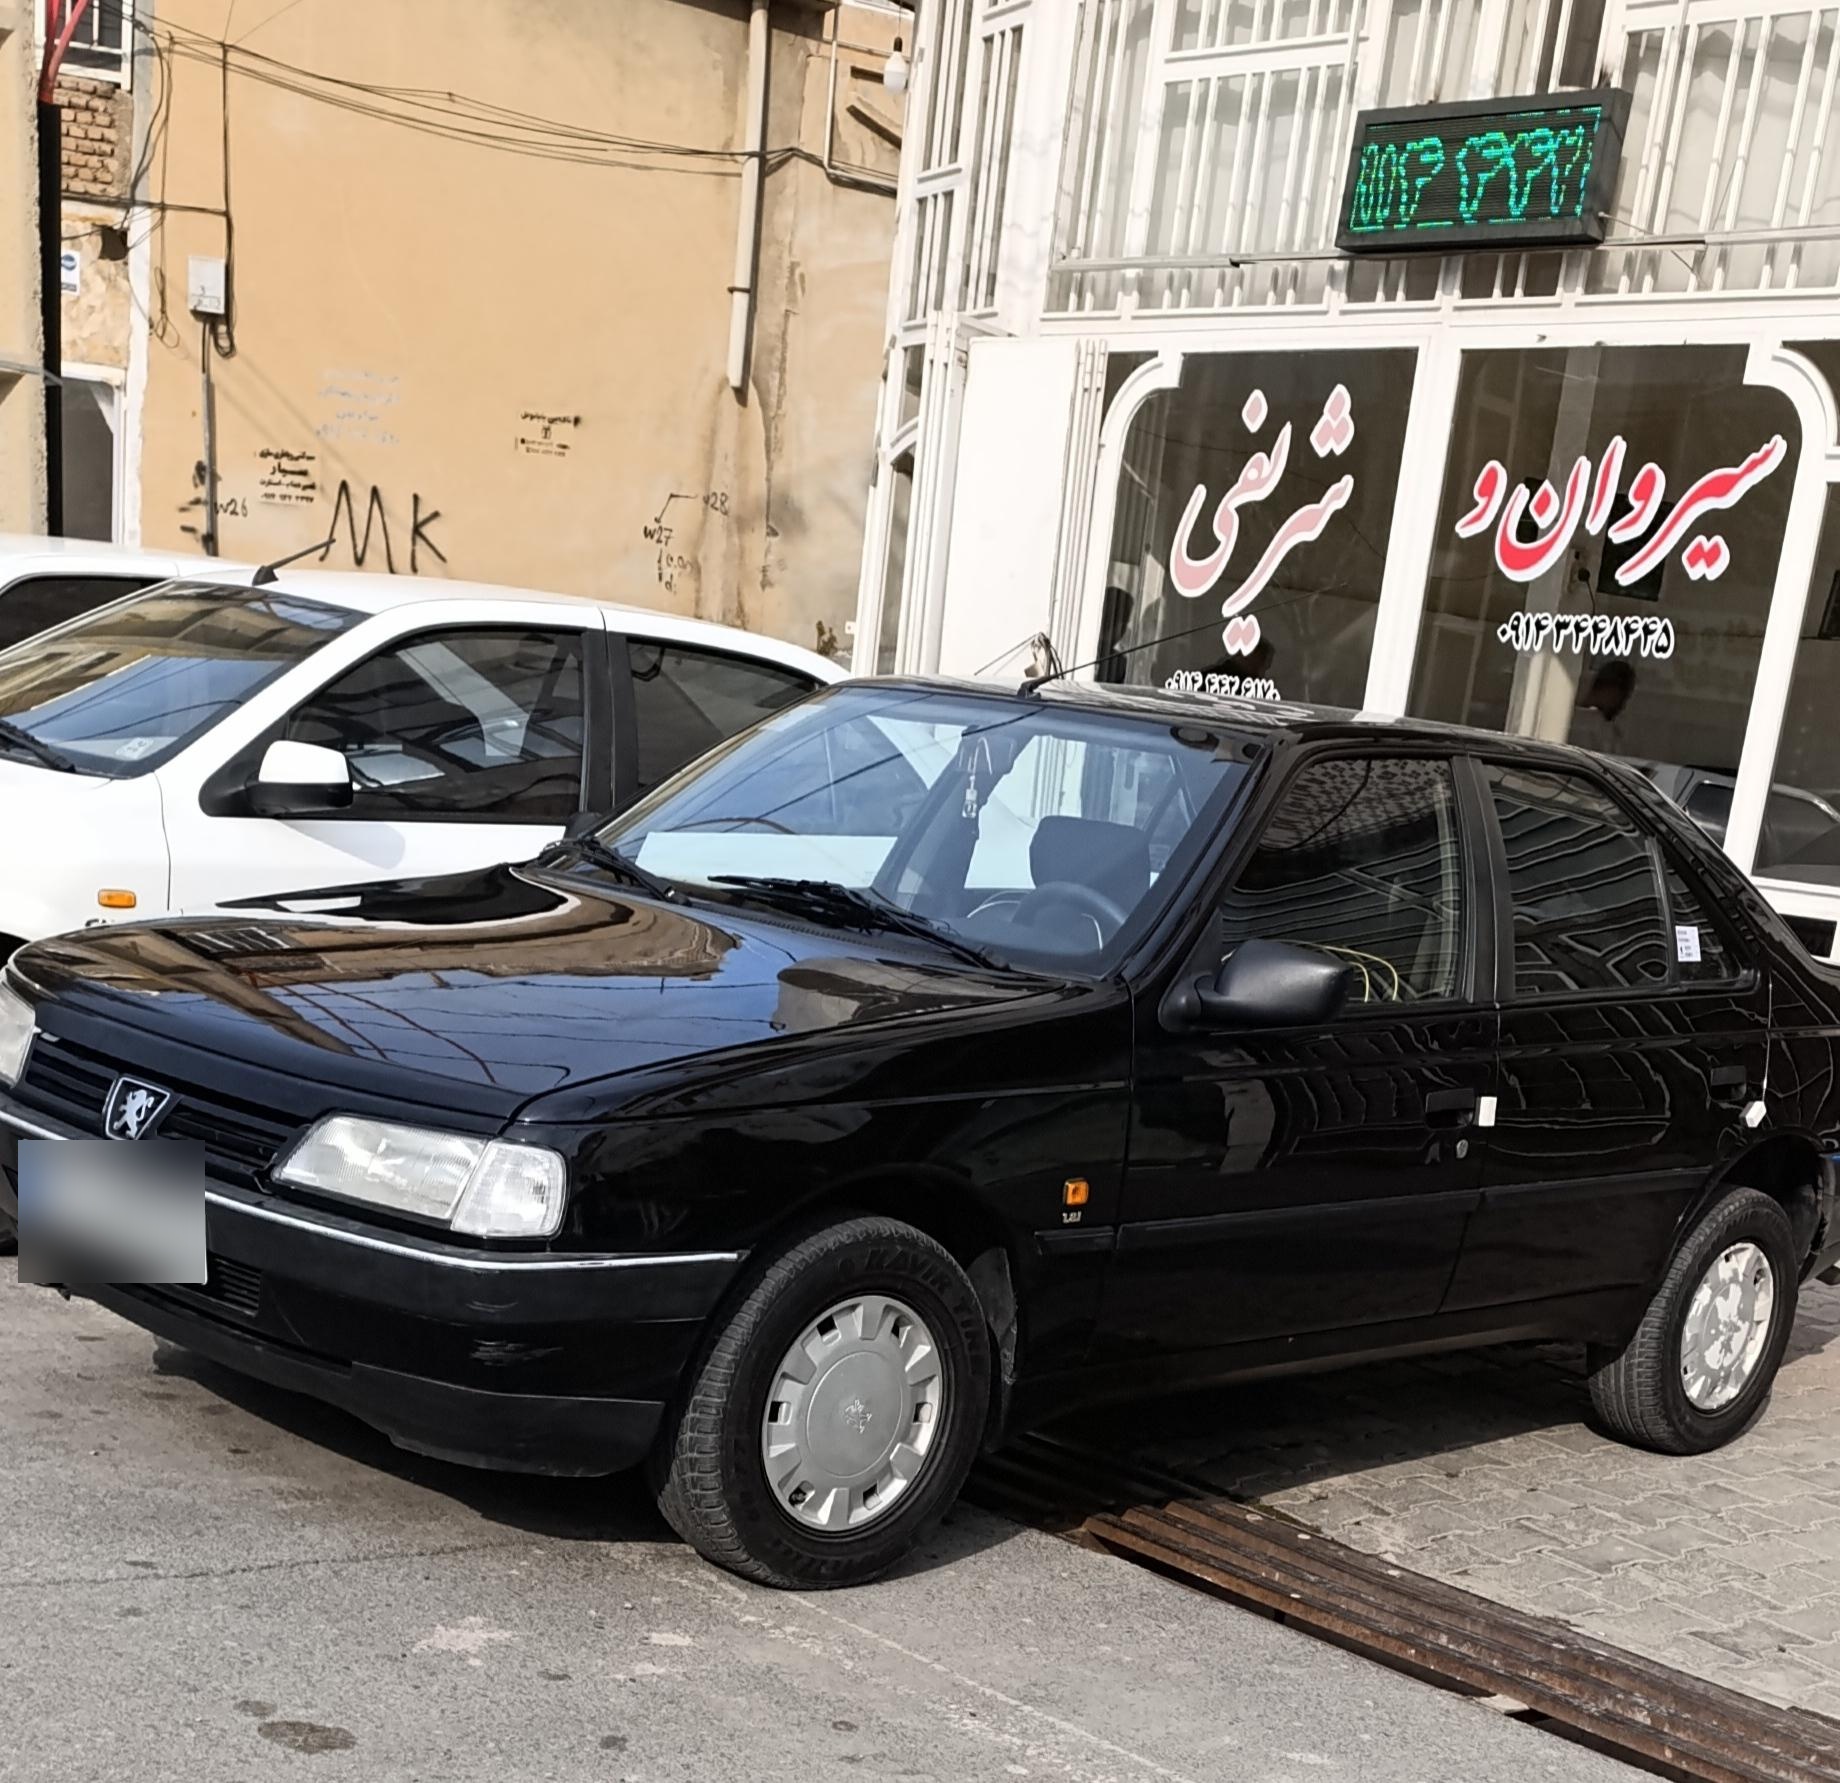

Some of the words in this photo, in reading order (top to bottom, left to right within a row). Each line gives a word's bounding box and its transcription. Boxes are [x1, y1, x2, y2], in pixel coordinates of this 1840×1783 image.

[1169, 383, 1355, 655] شریفی
[1454, 459, 1507, 538] و
[1493, 433, 1788, 584] سیروان
